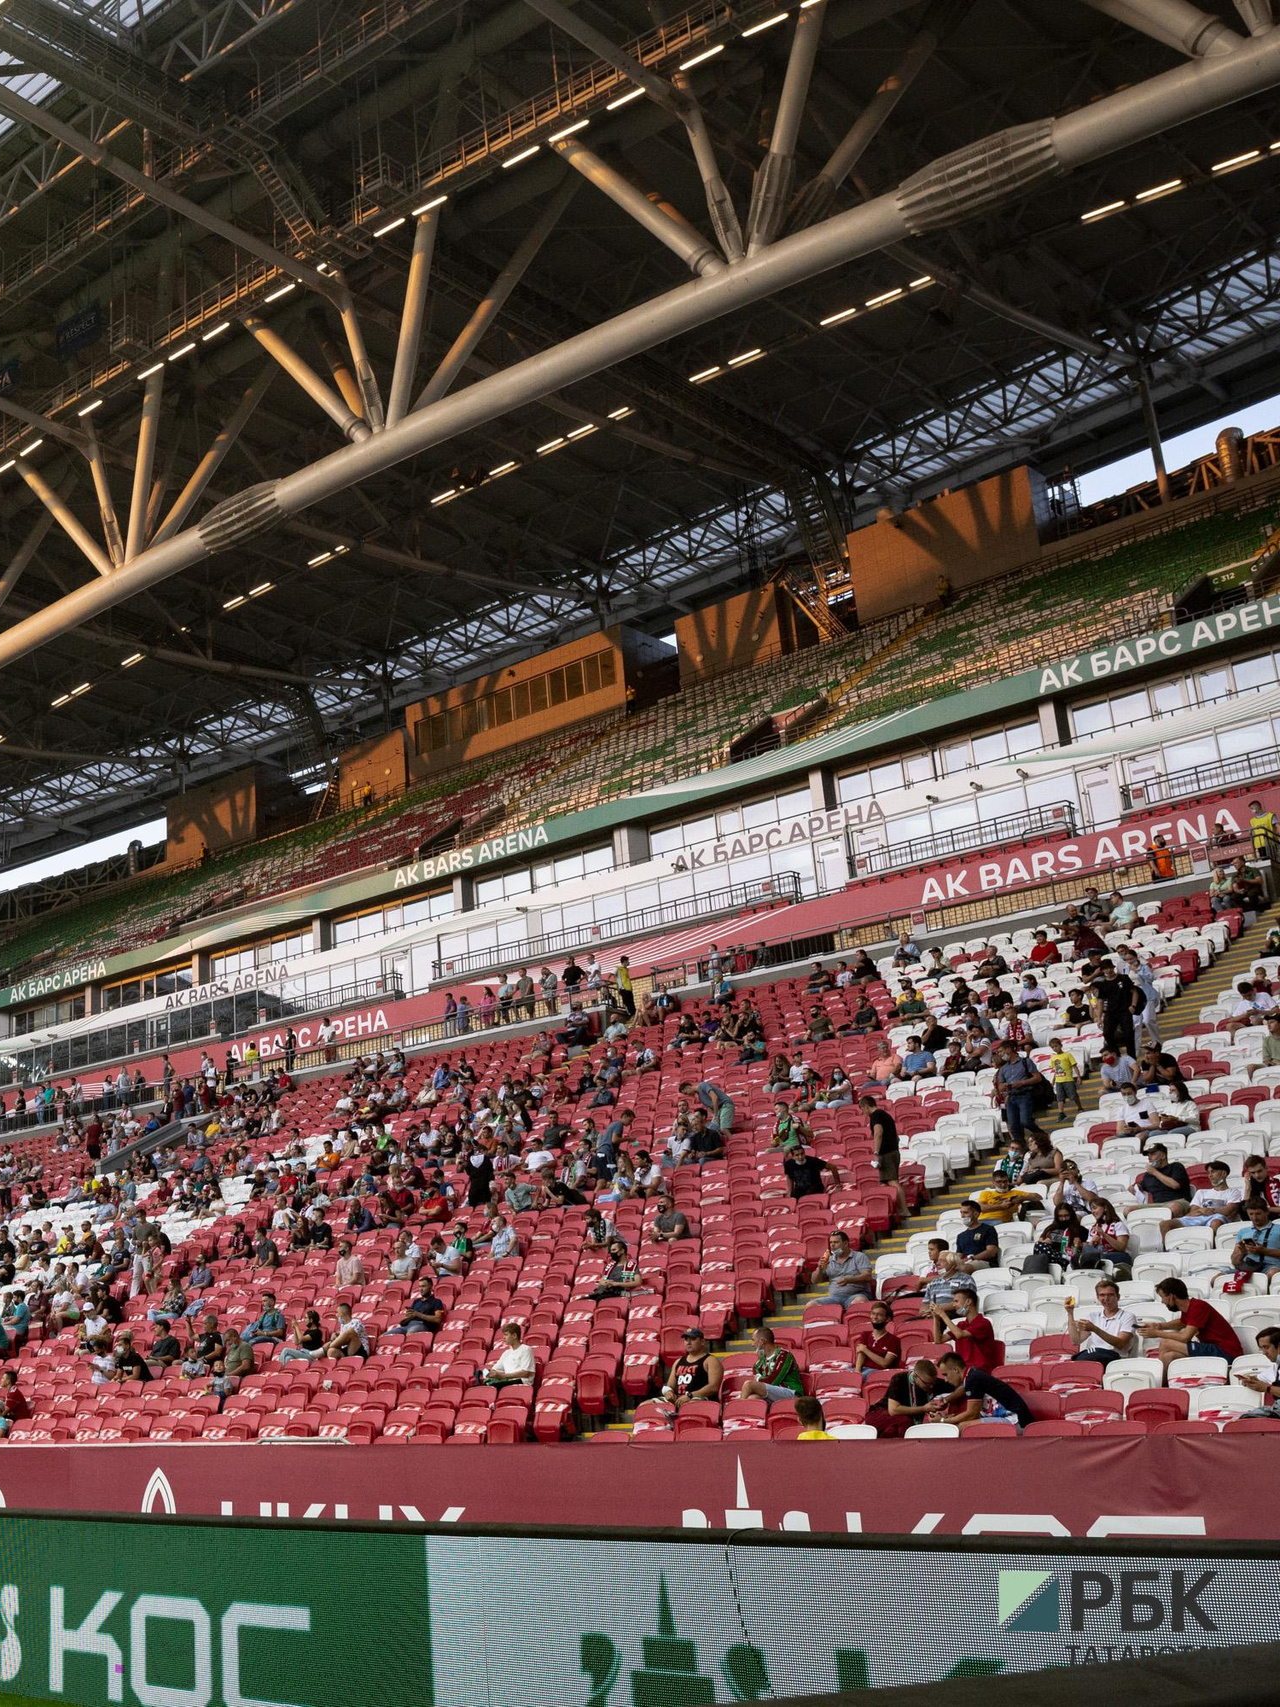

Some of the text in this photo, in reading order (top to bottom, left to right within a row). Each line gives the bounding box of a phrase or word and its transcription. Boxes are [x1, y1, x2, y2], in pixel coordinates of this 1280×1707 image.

[1220, 572, 1235, 583] 312
[1039, 598, 1280, 694] АК БАРС АРЕН
[393, 826, 549, 889] AK BARS ARENA
[675, 801, 885, 871] АК БАРС АРЕНА
[921, 808, 1242, 904] AK BARS ARENA
[9, 960, 107, 1004] АК БАРС АРЕНА
[165, 964, 290, 1010] AK BARS ARENA
[258, 1028, 311, 1057] БАС
[677, 1374, 693, 1385] DO
